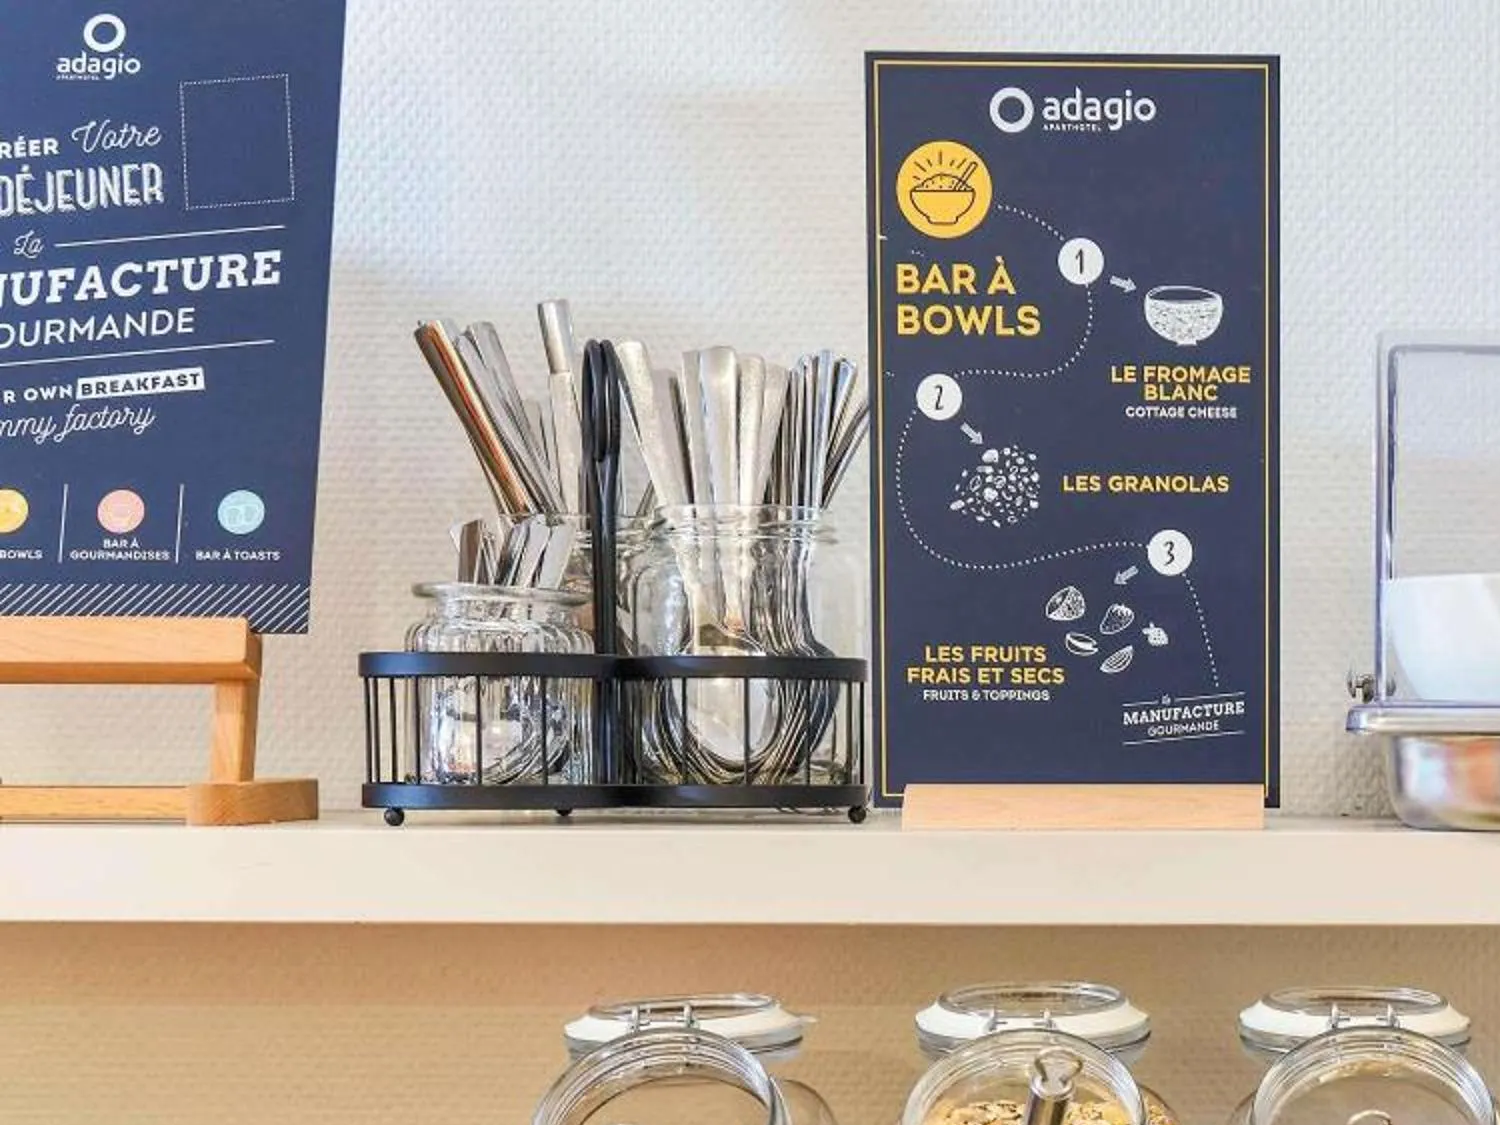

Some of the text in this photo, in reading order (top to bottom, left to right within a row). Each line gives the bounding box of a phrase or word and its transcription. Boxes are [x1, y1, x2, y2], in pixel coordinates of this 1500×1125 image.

[56, 51, 141, 80] adagio
[1042, 86, 1157, 131] adagio
[71, 119, 162, 153] Votre
[0, 250, 282, 308] UFACTURE
[896, 256, 1017, 295] BAR À
[897, 304, 1041, 337] BOWLS
[1111, 366, 1252, 384] LE FROMAGE
[24, 385, 73, 403] OWN
[81, 373, 201, 397] BREAKFAST
[1144, 384, 1218, 401] BLANC
[1125, 406, 1238, 419] COTTAGE CHEESE
[54, 403, 156, 443] factory
[1063, 475, 1231, 493] LES GRANOLAS
[103, 537, 139, 549] BAR À
[70, 550, 170, 560] GOURMANDISES
[195, 547, 281, 561] BAR À TOASTS
[925, 646, 1047, 663] LES FRUITS
[907, 667, 1065, 684] FRAIS ET SECS
[923, 690, 1050, 702] FRUITS & TOPPINGS
[1123, 701, 1245, 725] MANUFACTURE
[1147, 720, 1220, 737] GOURMANDE
